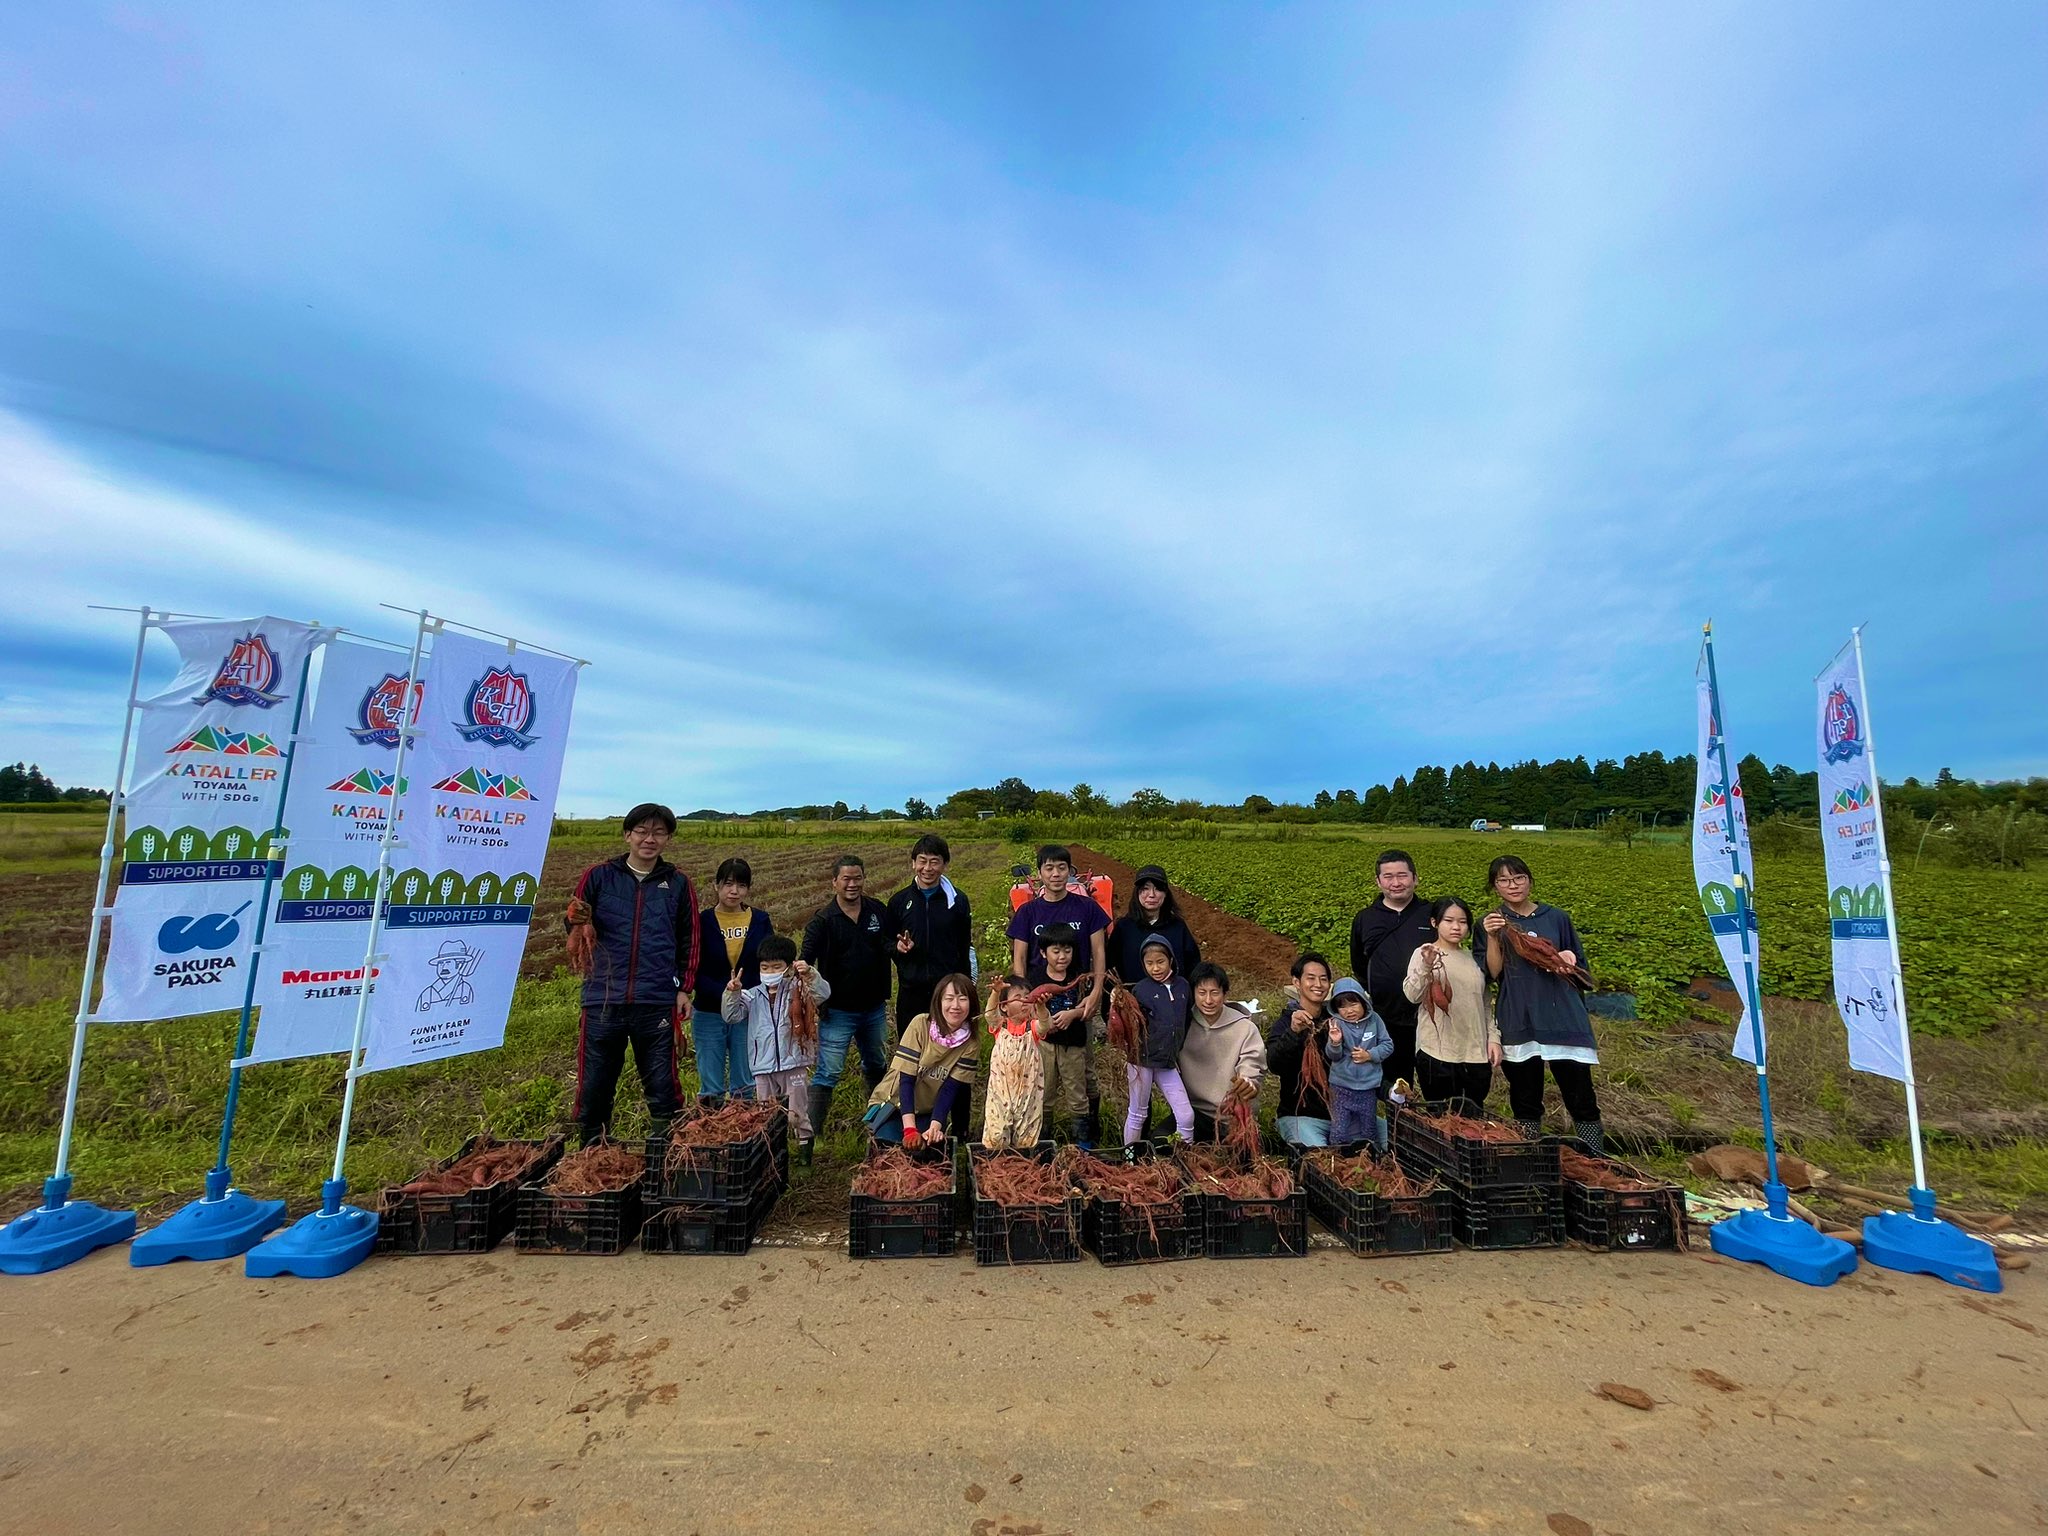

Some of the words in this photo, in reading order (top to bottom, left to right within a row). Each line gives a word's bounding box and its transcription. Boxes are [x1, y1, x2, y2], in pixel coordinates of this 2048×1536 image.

[165, 762, 278, 782] KATALLER
[193, 780, 248, 791] TOYAMA
[181, 791, 218, 802] WITH
[222, 793, 260, 803] SDGs
[434, 804, 528, 826] KATALLER
[344, 832, 375, 841] WITH
[457, 823, 501, 836] TOYAMA
[446, 834, 478, 847] WITH
[481, 838, 509, 848] SDGs
[147, 864, 241, 880] SUPPORTED
[408, 909, 486, 924] SUPPORTED
[495, 909, 512, 921] BY
[153, 956, 236, 976] SAKURA
[168, 970, 222, 989] PAXX
[410, 1023, 443, 1037] FUNNY
[446, 1018, 471, 1030] FARM
[412, 1029, 465, 1046] VEGETABLE
